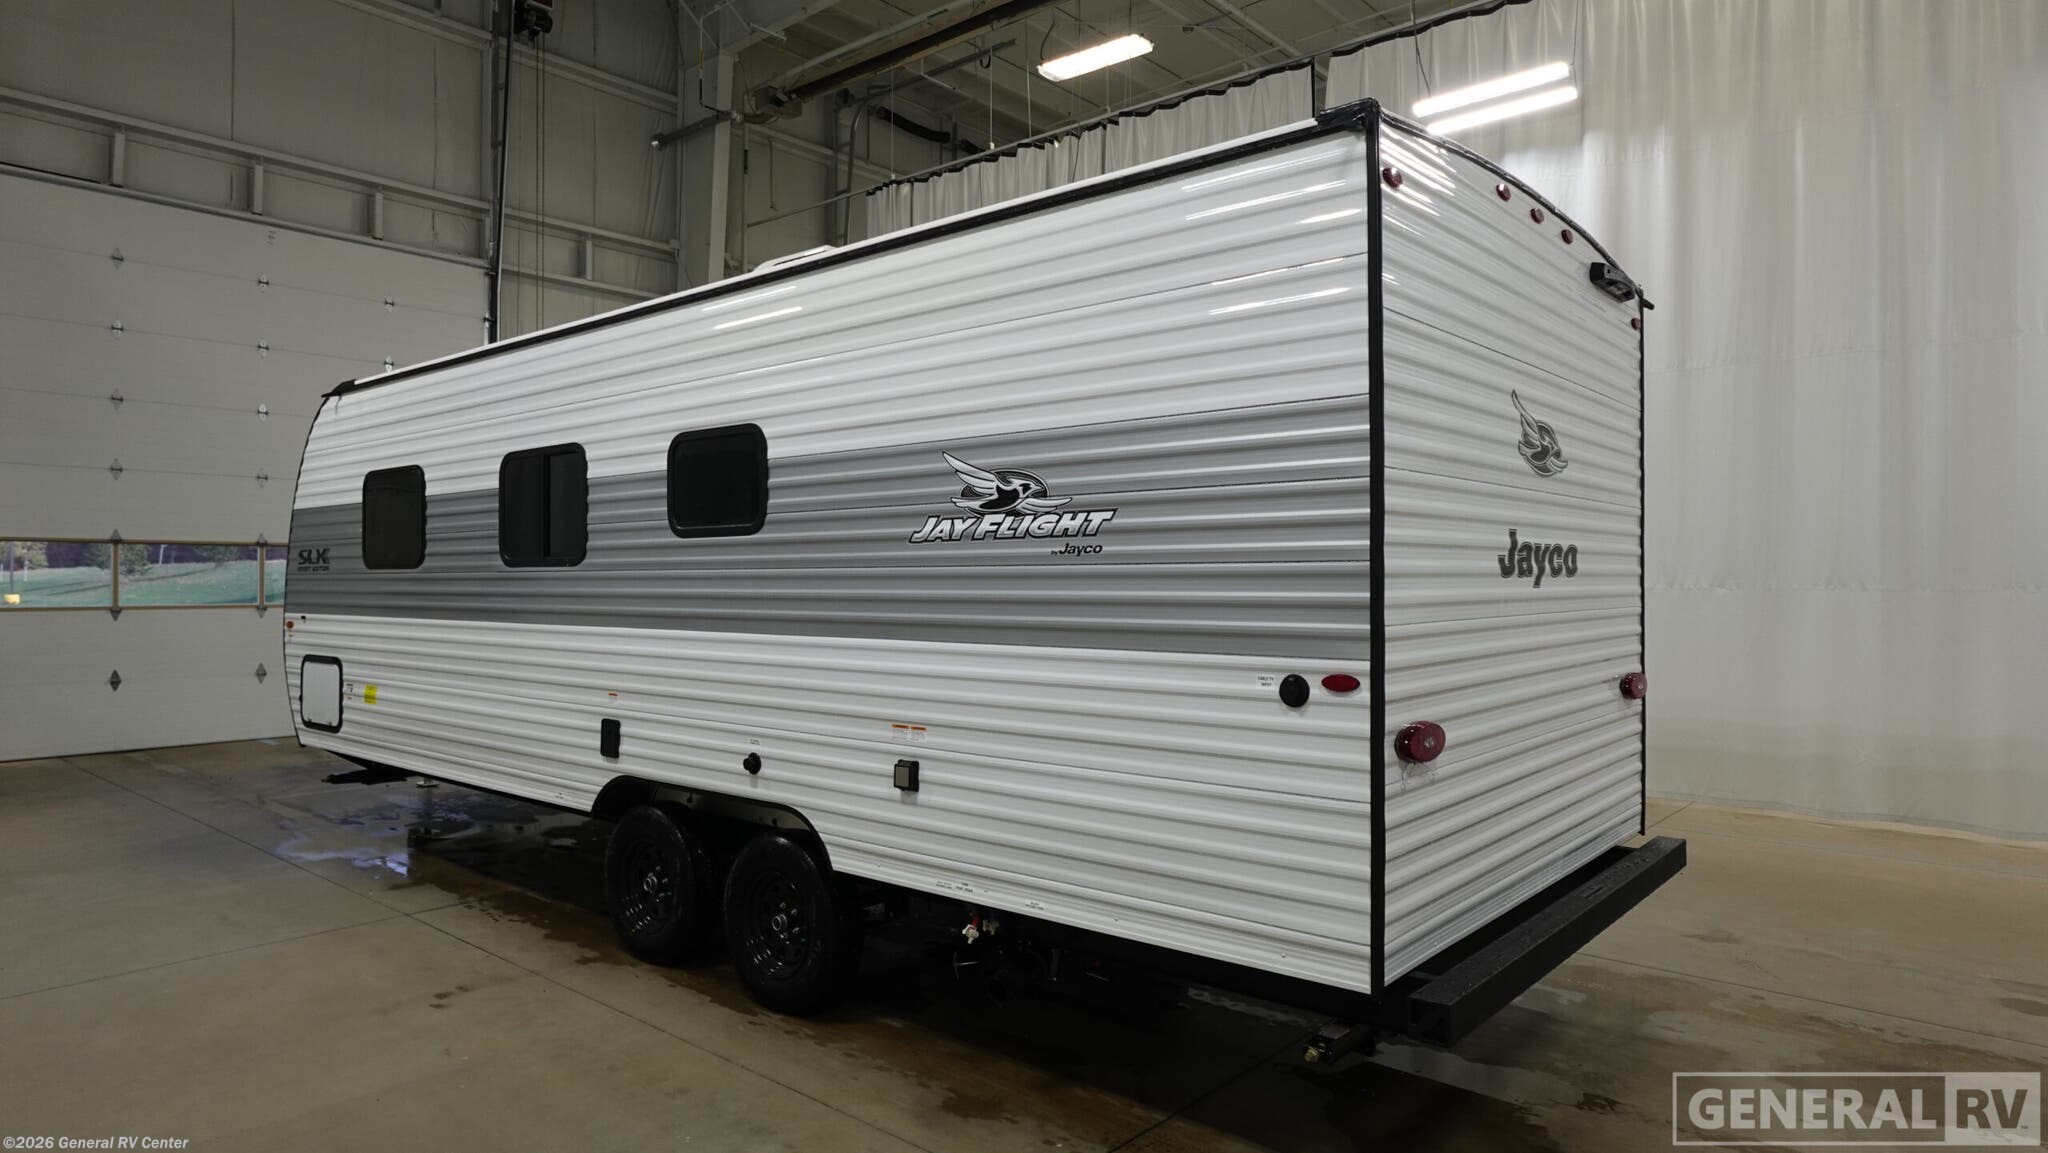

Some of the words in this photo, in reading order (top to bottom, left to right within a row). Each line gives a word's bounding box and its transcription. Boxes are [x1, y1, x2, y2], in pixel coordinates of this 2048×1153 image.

[909, 515, 977, 544] JAY
[971, 508, 1119, 541] FLIGHT
[297, 548, 331, 565] SLK
[1059, 542, 1103, 557] Jayco
[1497, 528, 1578, 589] Jayco
